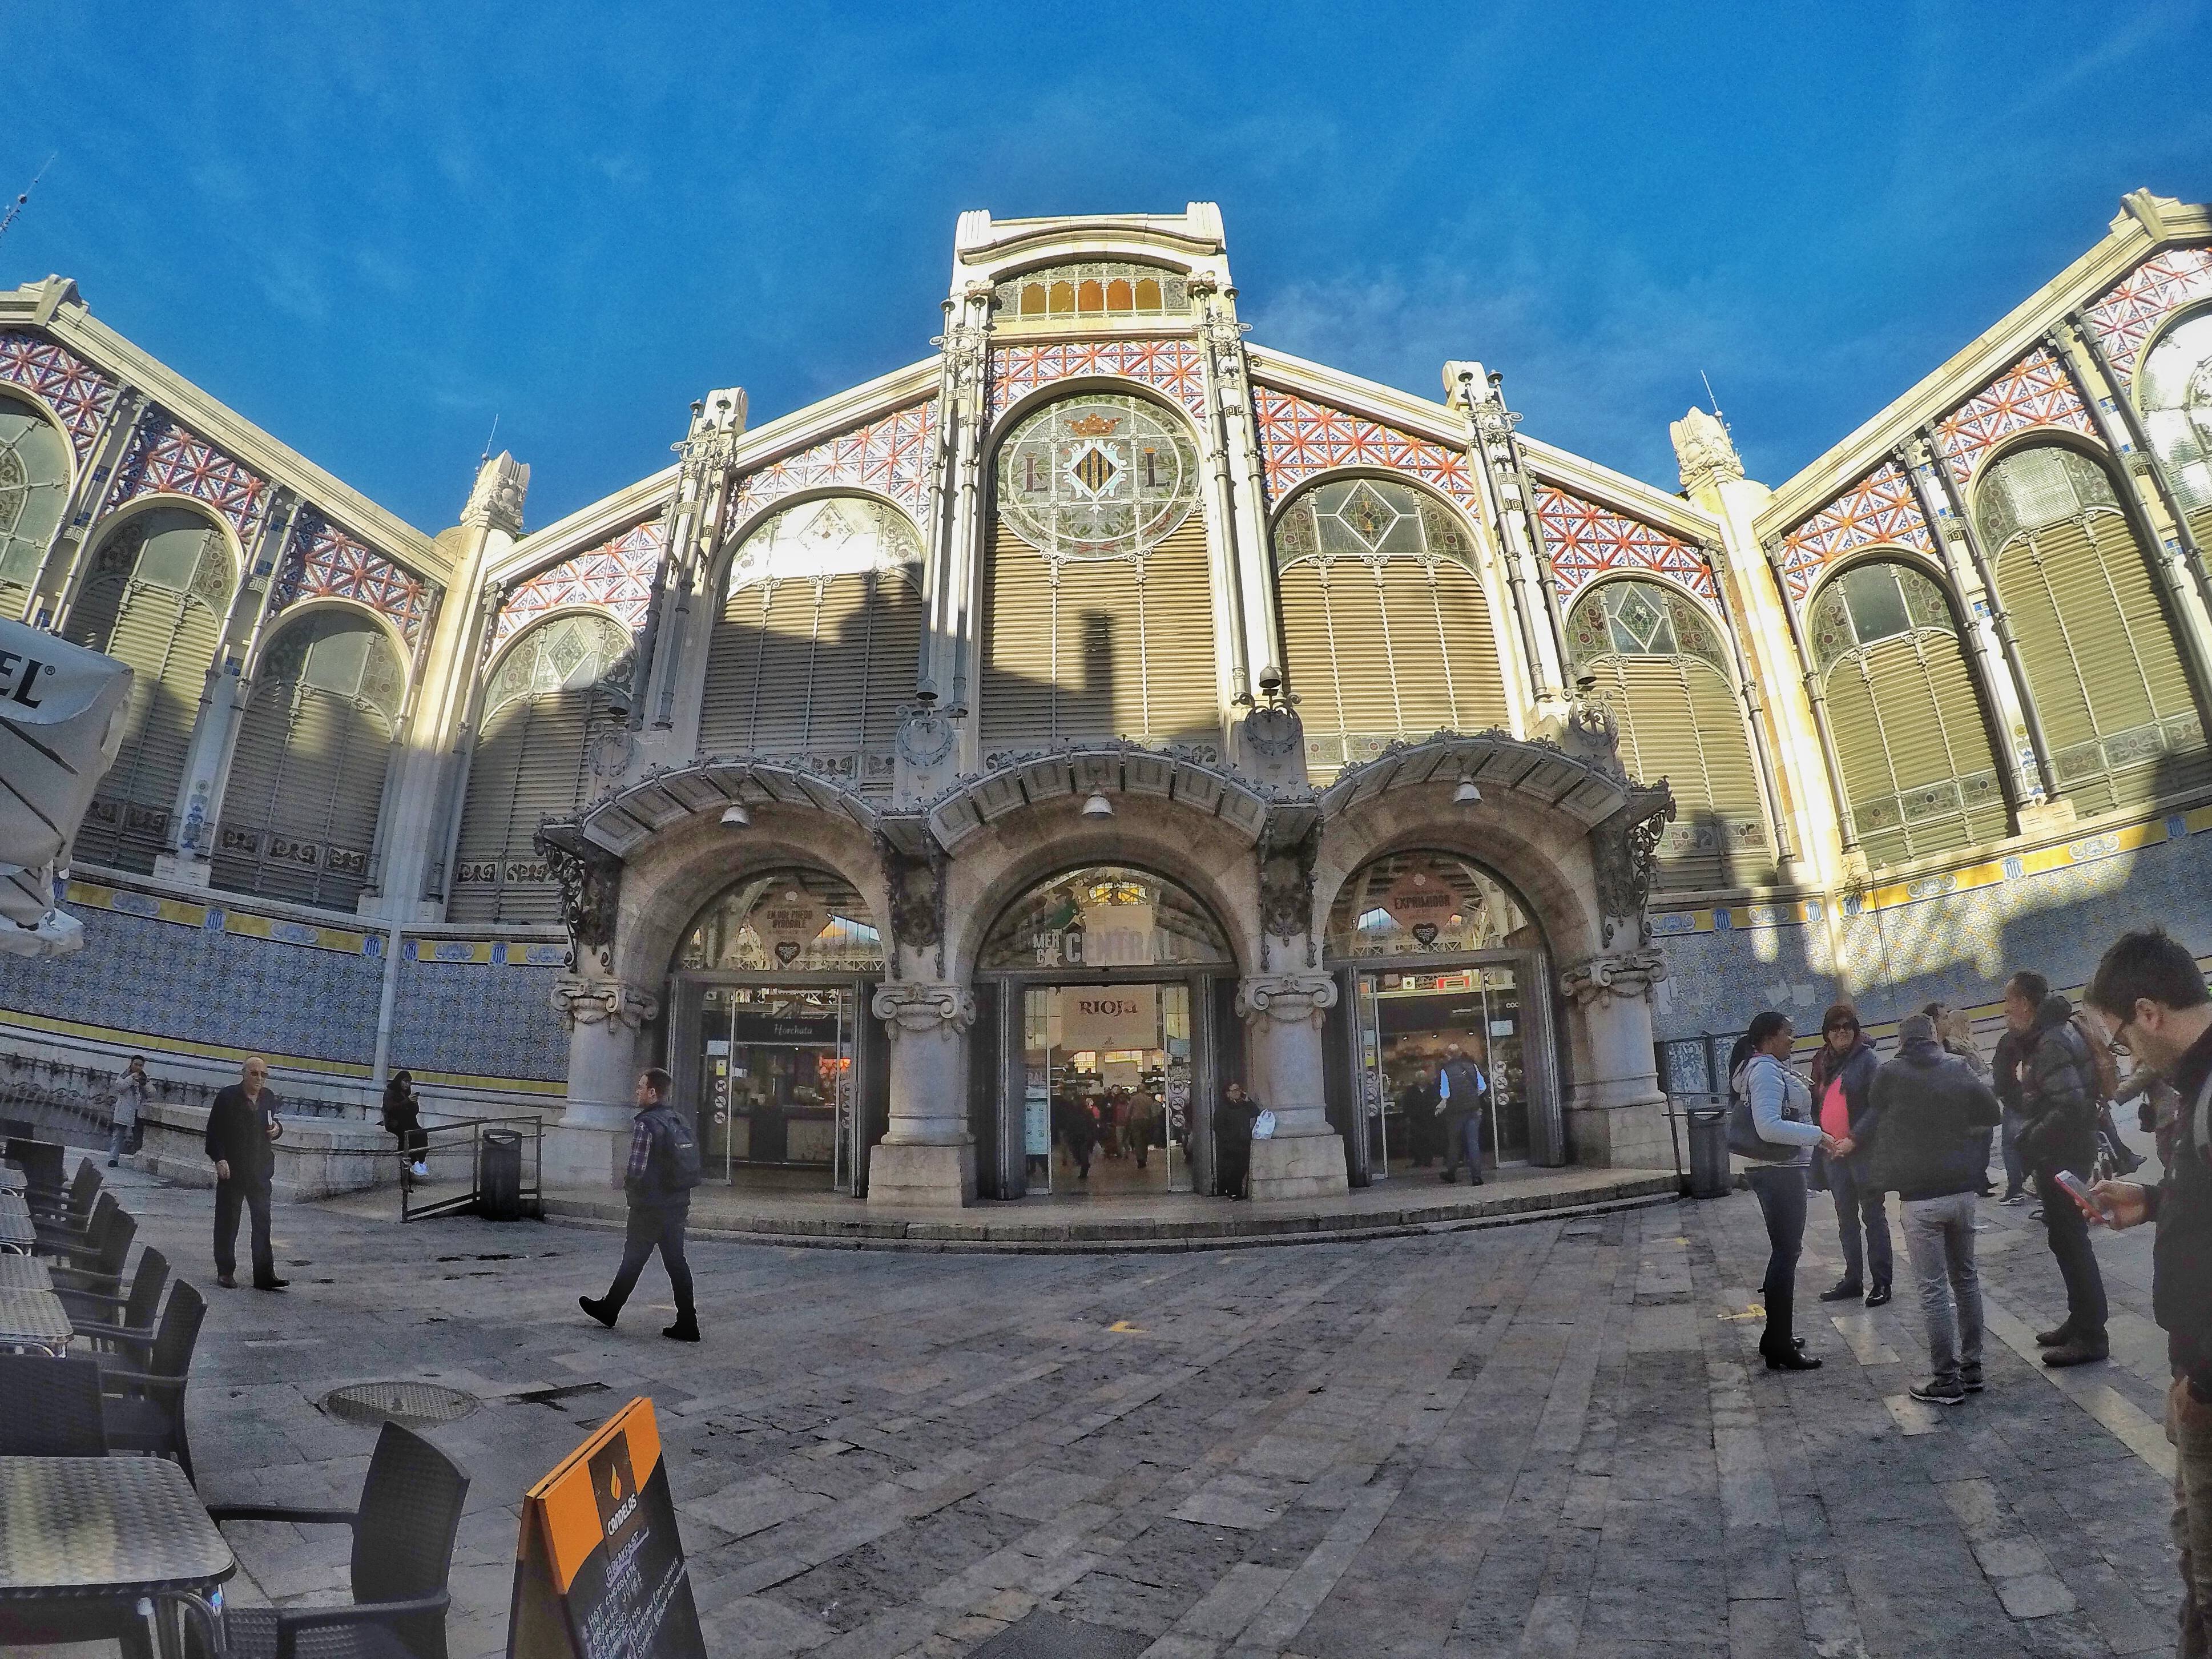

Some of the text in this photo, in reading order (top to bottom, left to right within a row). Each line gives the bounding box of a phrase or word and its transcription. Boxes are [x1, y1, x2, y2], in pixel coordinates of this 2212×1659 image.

[1066, 929, 1177, 963] CENTRAL
[774, 1024, 812, 1036] Horchata
[607, 1492, 637, 1536] CANDELAS
[606, 1531, 639, 1581] BREAKFAST
[587, 1561, 637, 1629] HOT CHOCOLATE
[592, 1572, 642, 1645] ORANGE JUICE
[636, 1625, 654, 1658] SWEET
